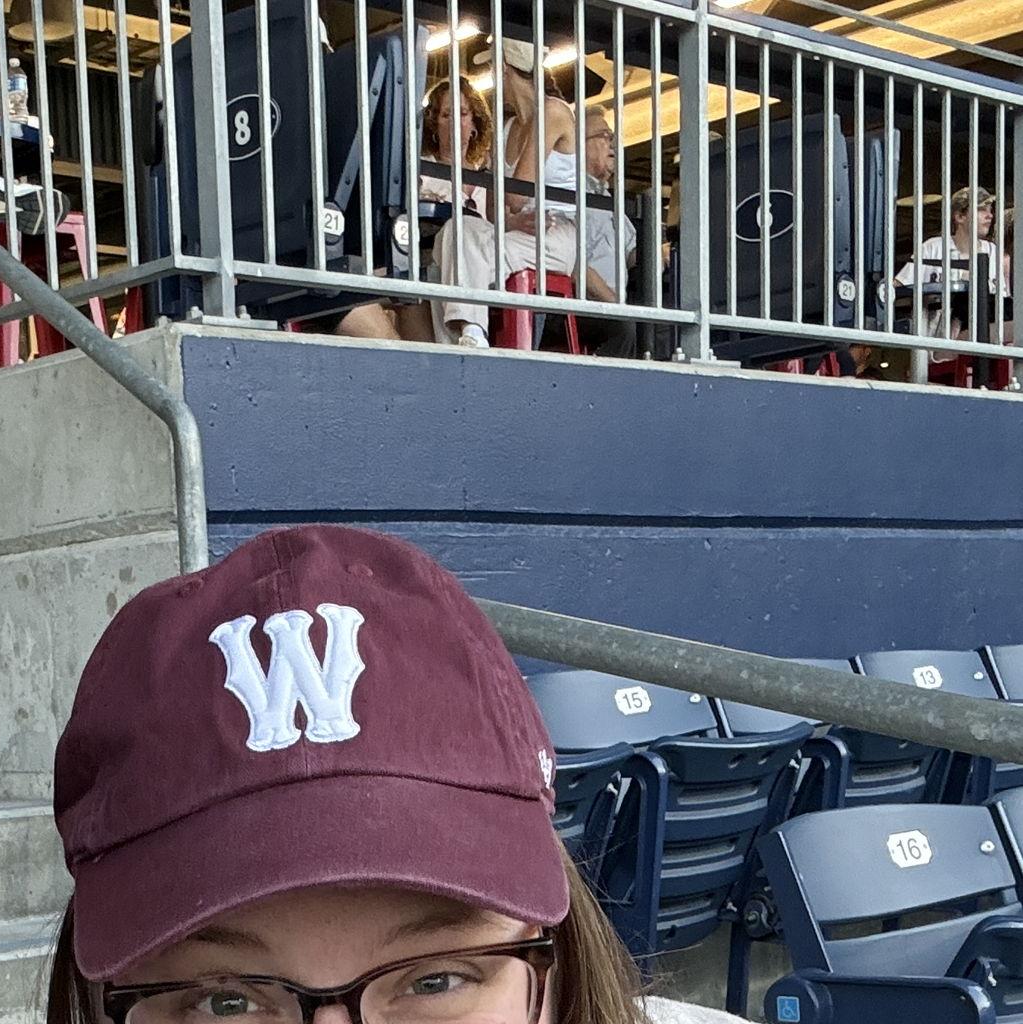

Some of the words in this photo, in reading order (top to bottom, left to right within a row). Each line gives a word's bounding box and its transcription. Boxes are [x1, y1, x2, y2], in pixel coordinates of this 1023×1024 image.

[234, 110, 252, 146] 8
[323, 212, 339, 231] 21
[209, 602, 366, 752] W
[919, 669, 936, 686] 13
[622, 692, 643, 710] 15
[896, 838, 922, 861] 16
